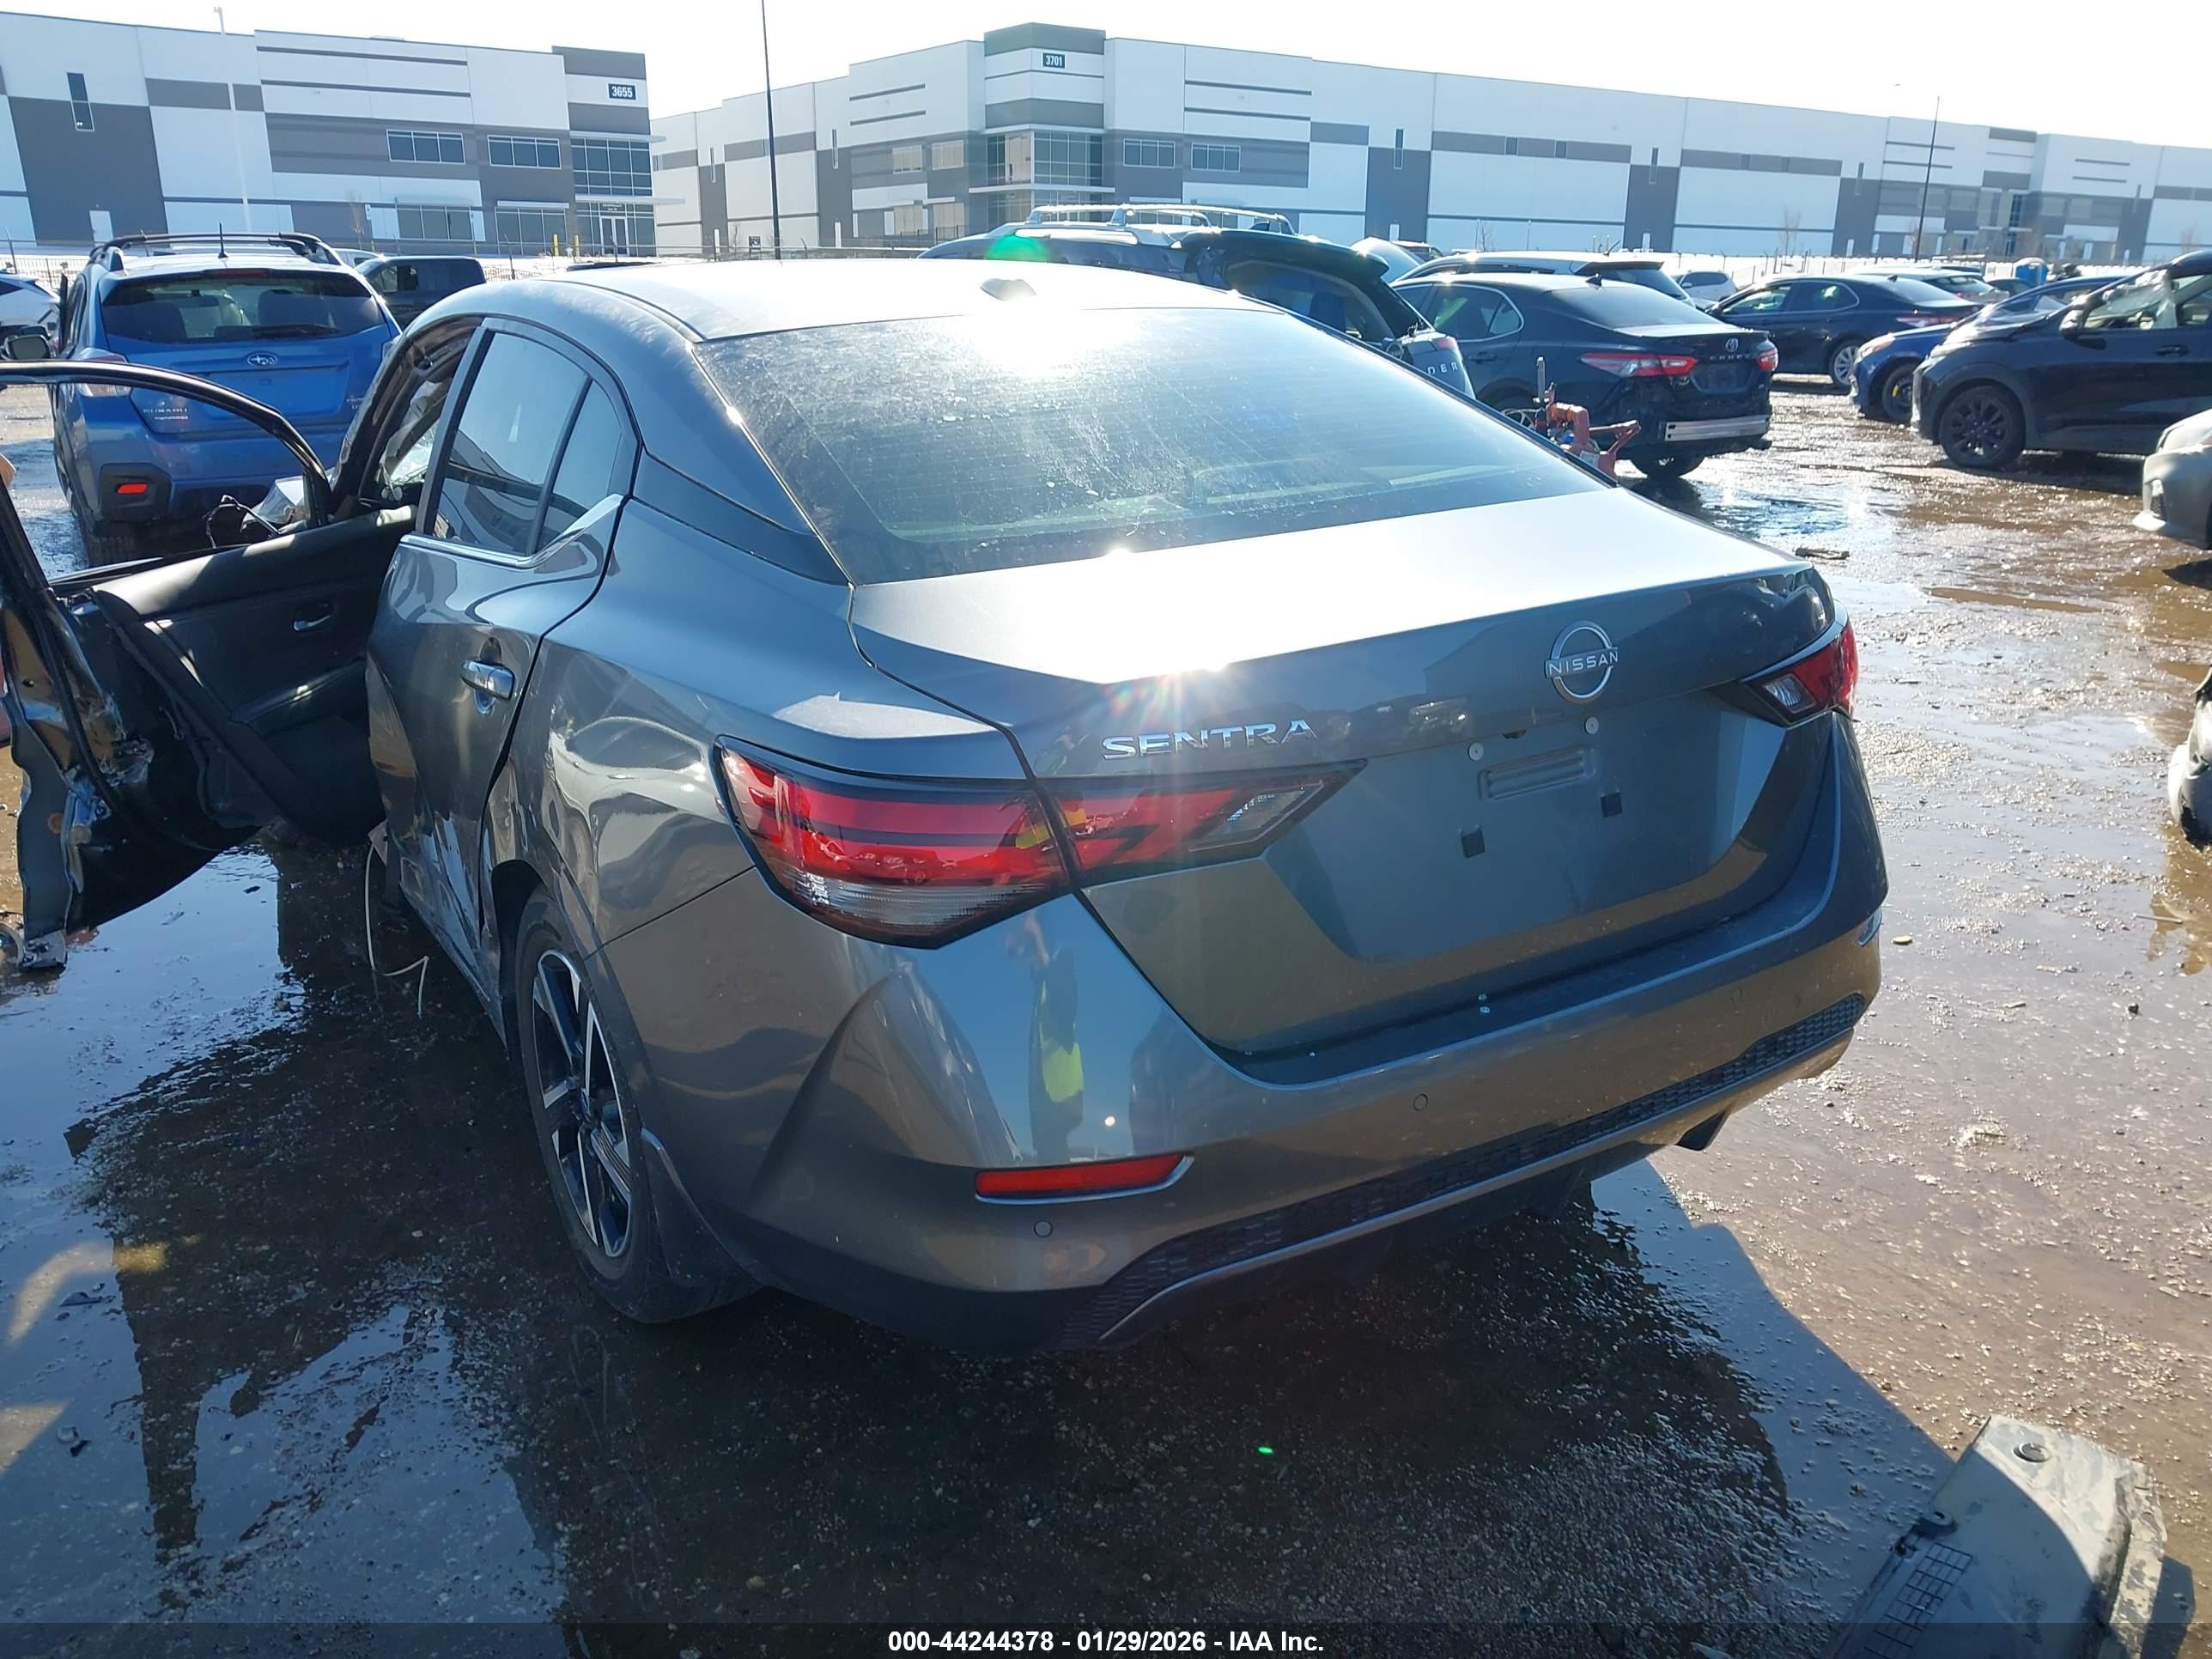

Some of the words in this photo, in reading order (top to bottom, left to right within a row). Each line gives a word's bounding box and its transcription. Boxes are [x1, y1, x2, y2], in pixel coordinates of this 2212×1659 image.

[1045, 55, 1062, 66] 3701
[611, 86, 633, 98] 3655
[1549, 651, 1619, 676] NISSAN
[1103, 720, 1317, 760] SENTRA
